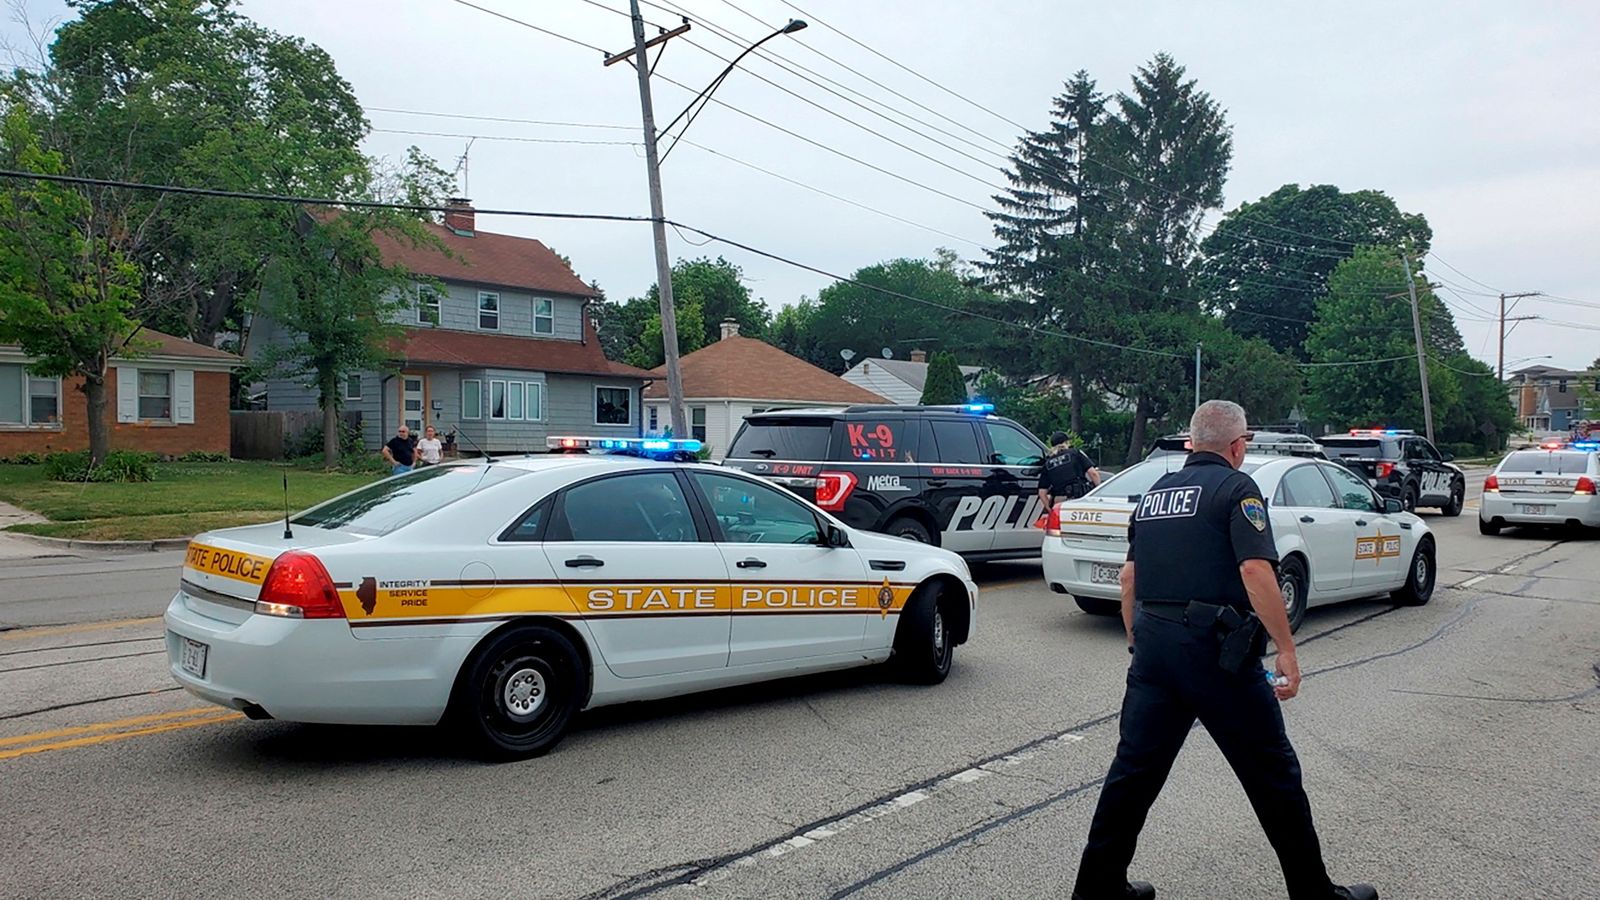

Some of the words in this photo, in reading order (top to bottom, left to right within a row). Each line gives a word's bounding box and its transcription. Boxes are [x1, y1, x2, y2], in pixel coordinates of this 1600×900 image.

[847, 423, 893, 448] K-9
[853, 448, 896, 458] UNIT
[772, 464, 790, 474] K-9
[792, 465, 814, 475] UNIT
[867, 474, 900, 490] Metra
[1420, 471, 1454, 491] POLICE
[946, 495, 1051, 531] POLIC
[1140, 490, 1195, 517] POLICE
[1071, 511, 1102, 522] STATE
[211, 552, 264, 579] POLICE
[379, 580, 428, 588] INTEGRITY
[587, 588, 716, 610] STATE
[741, 589, 858, 608] POLICE
